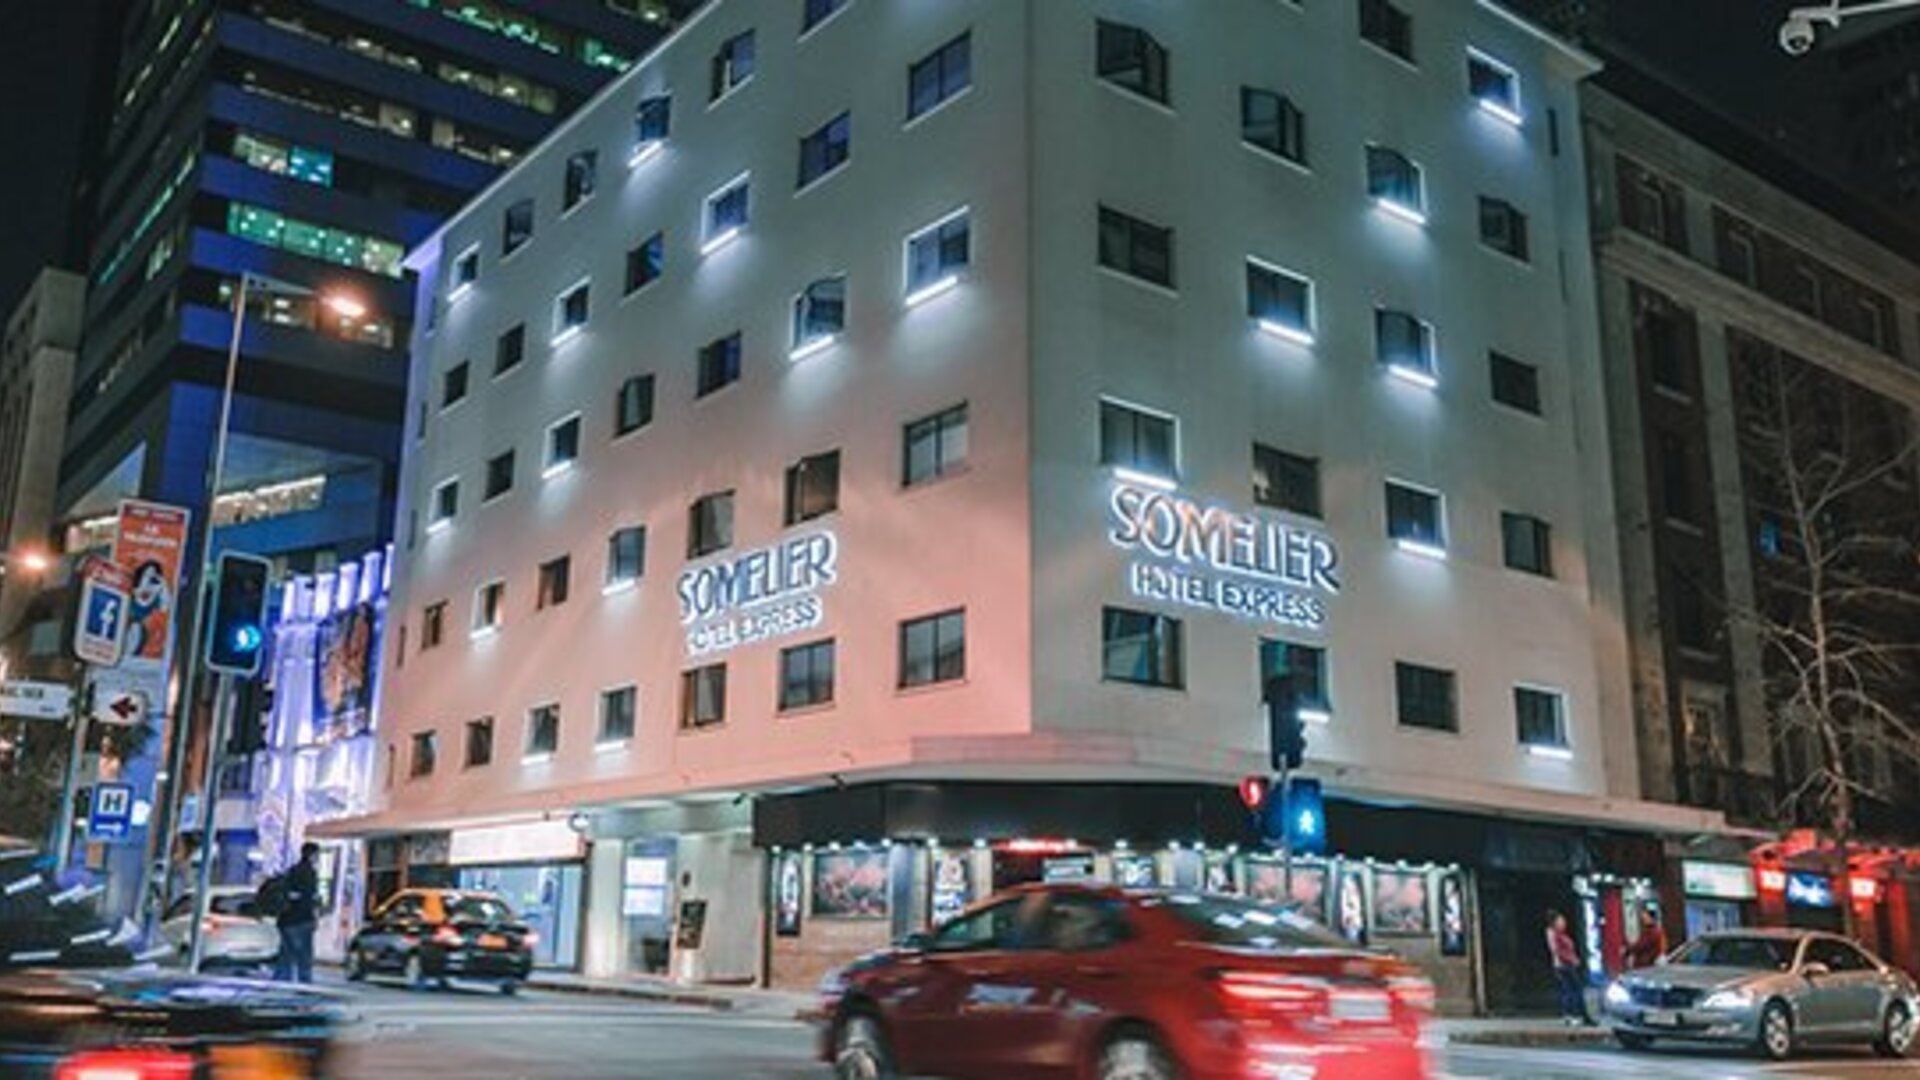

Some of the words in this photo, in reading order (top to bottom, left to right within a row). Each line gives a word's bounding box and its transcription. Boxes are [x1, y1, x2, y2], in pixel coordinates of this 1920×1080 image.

[677, 530, 838, 625] SOMELIER
[1109, 482, 1341, 594] SOMELIER
[1131, 560, 1216, 608] HOTEL
[1216, 578, 1325, 629] EXPRESS
[102, 792, 122, 812] H
